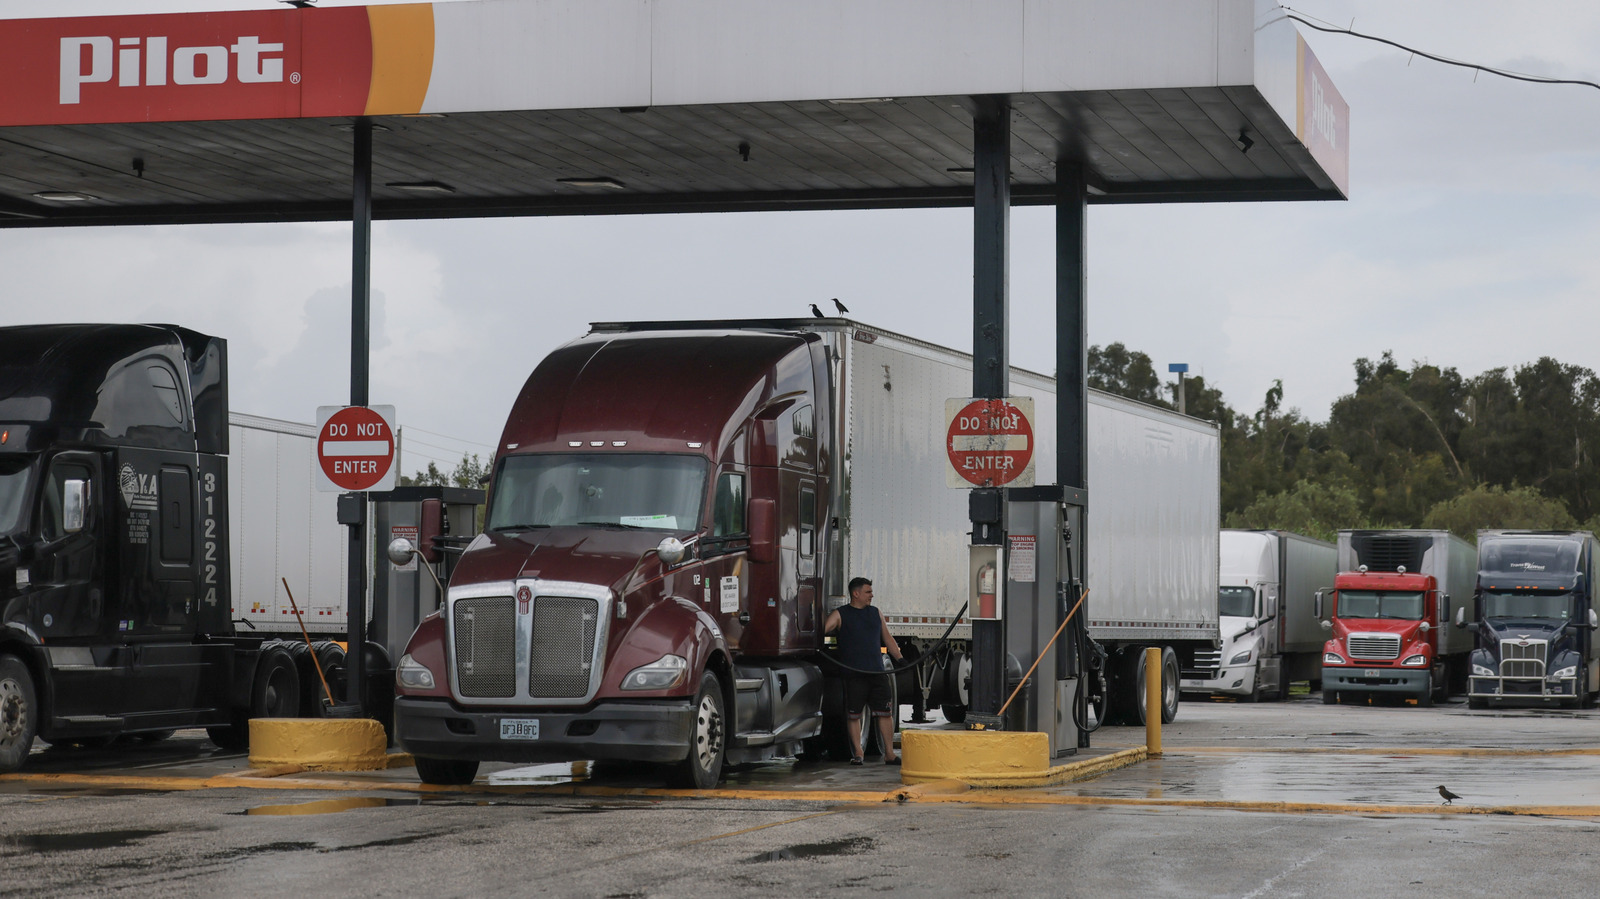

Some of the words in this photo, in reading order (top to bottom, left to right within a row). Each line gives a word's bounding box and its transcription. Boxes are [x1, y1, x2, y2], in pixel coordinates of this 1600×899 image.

[329, 423, 348, 437] DO
[357, 422, 383, 436] NOT
[960, 416, 980, 431] DO
[990, 416, 1021, 431] NOT
[334, 460, 377, 474] ENTER
[965, 455, 1014, 470] ENTER
